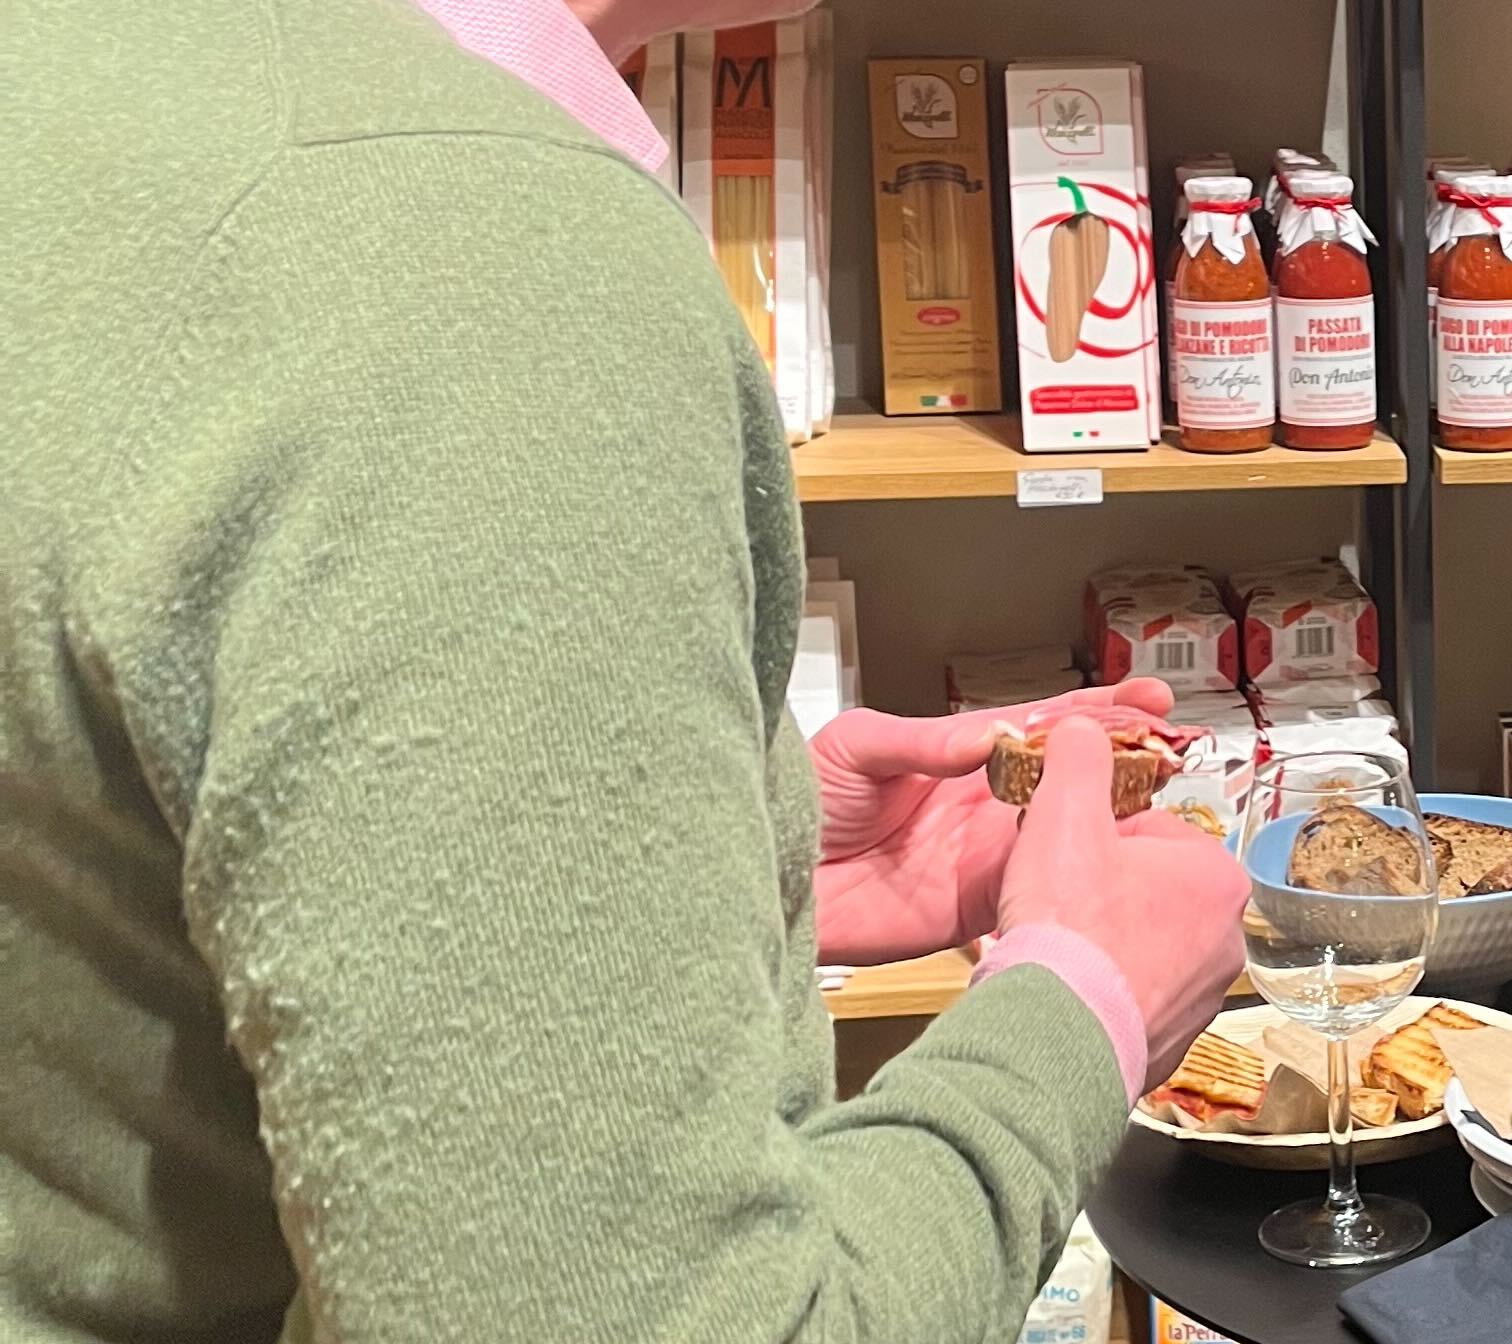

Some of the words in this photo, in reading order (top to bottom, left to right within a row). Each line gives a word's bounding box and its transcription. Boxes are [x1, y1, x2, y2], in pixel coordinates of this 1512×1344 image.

[716, 57, 770, 107] M
[1308, 317, 1362, 335] PASSATA
[1467, 319, 1479, 334] DI
[1295, 336, 1306, 352] DI
[1289, 367, 1320, 388] Don
